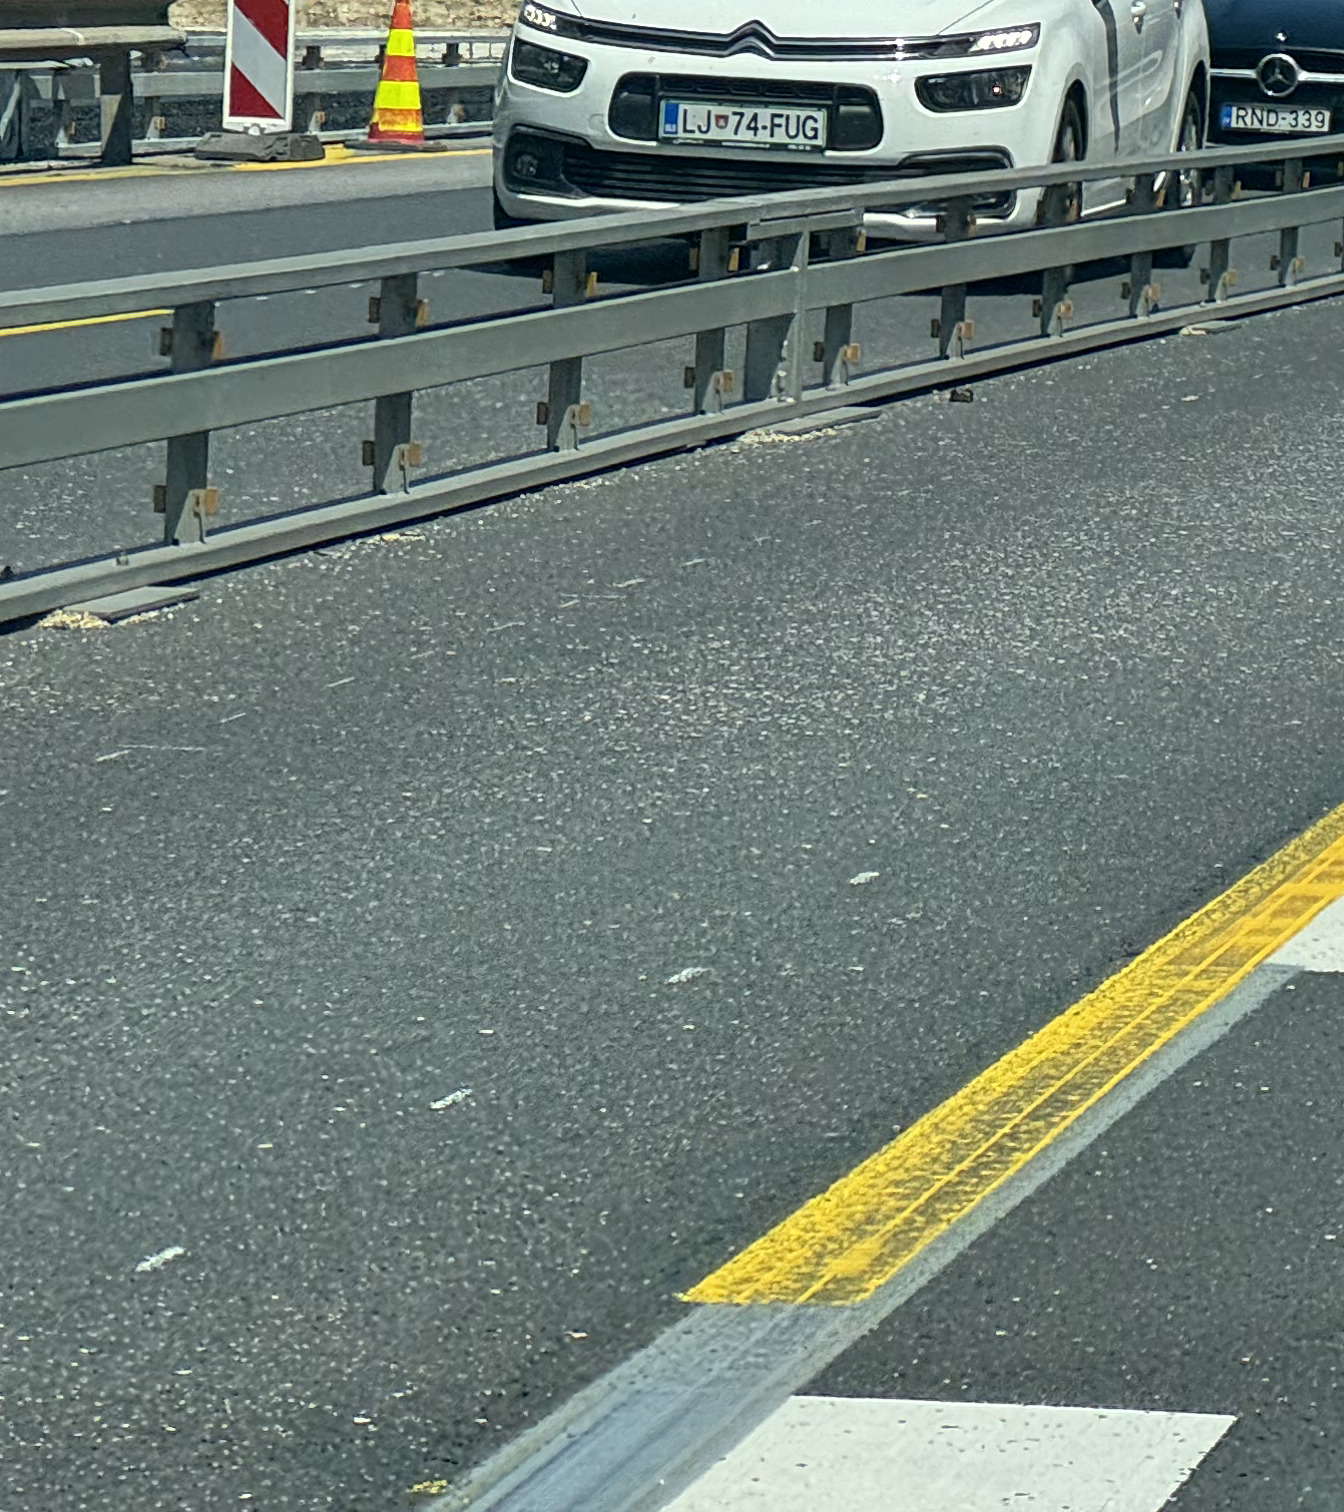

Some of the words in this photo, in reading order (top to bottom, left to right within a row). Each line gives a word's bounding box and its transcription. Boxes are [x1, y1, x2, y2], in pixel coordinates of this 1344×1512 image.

[682, 108, 711, 135] LJ
[731, 111, 819, 140] 74-FUG
[1235, 106, 1326, 129] RND-339
